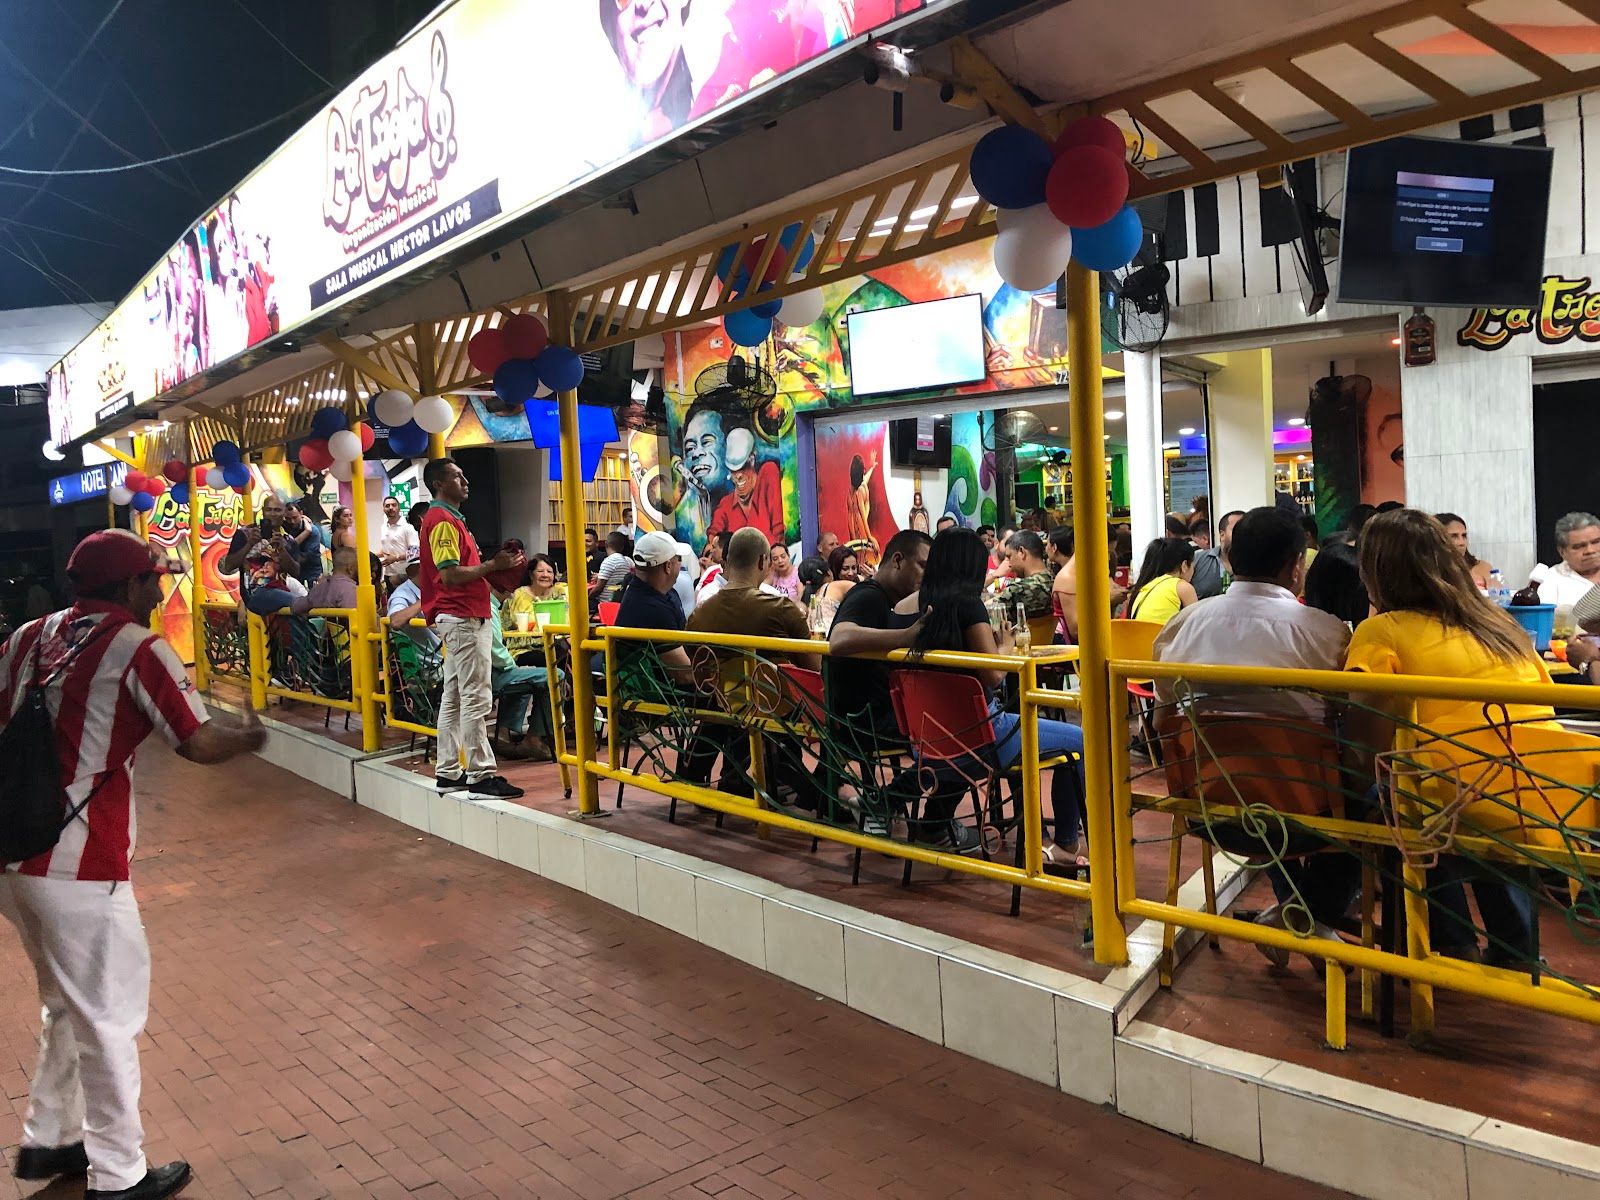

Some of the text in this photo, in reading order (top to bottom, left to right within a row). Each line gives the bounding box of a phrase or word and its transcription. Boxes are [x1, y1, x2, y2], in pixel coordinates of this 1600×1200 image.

[399, 179, 438, 217] Musical
[325, 200, 473, 295] SALA MUSICAL HECTOR LAVOE
[81, 469, 107, 493] HOTEL
